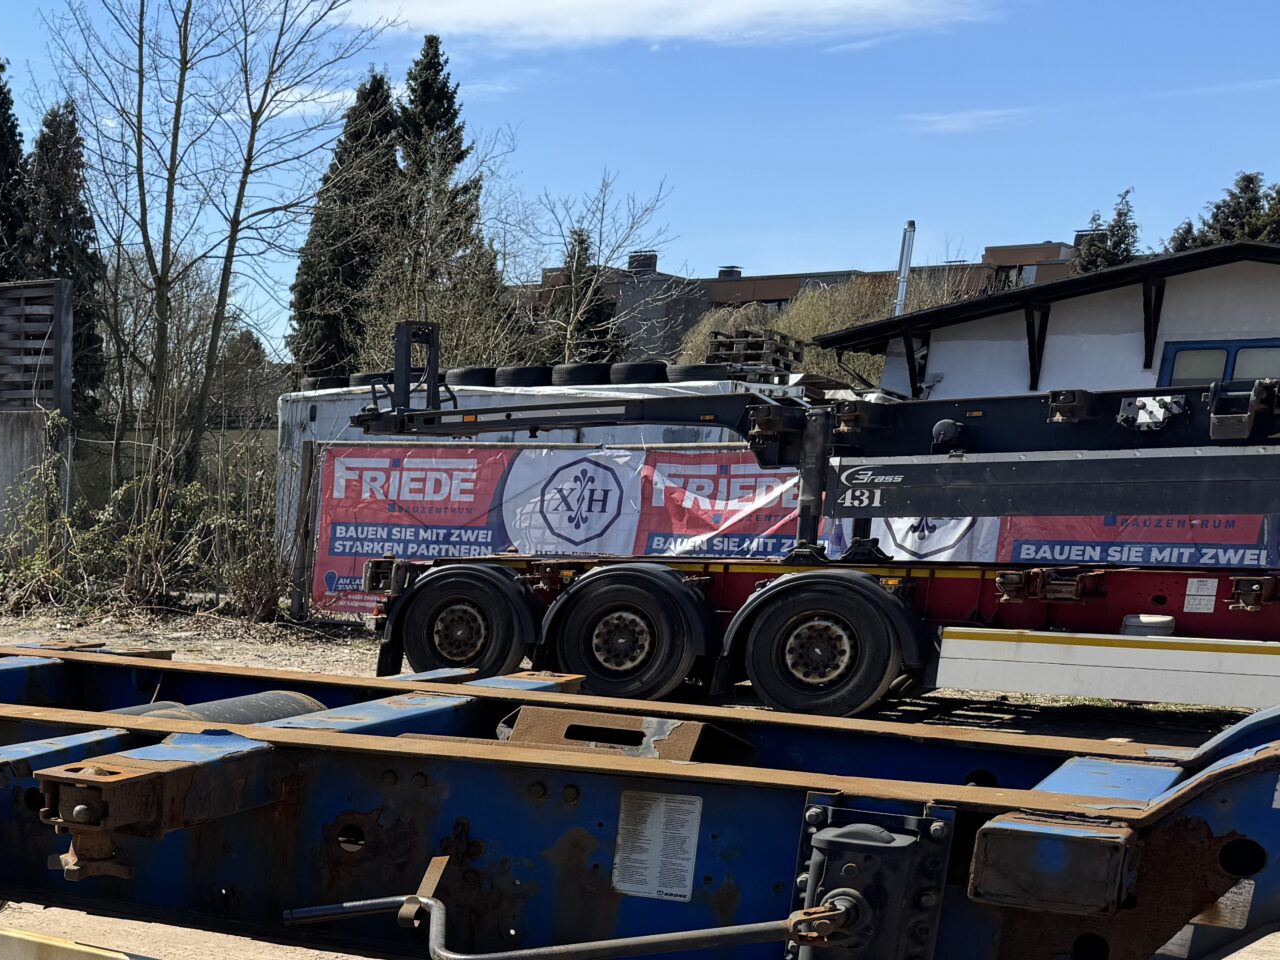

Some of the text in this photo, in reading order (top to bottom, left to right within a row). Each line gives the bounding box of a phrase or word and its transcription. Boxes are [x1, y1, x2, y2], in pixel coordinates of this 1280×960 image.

[333, 458, 478, 501] FRIEDE
[837, 489, 882, 507] 431
[1120, 518, 1237, 529] BAUZENTRUM
[336, 526, 493, 543] BAUEN SIE MIT ZWEI
[334, 541, 493, 557] STARKEN PARTNERN
[652, 536, 708, 551] BAUEN
[713, 538, 739, 551] SIE
[1020, 544, 1269, 566] BAUEN SIE MIT ZWEI
